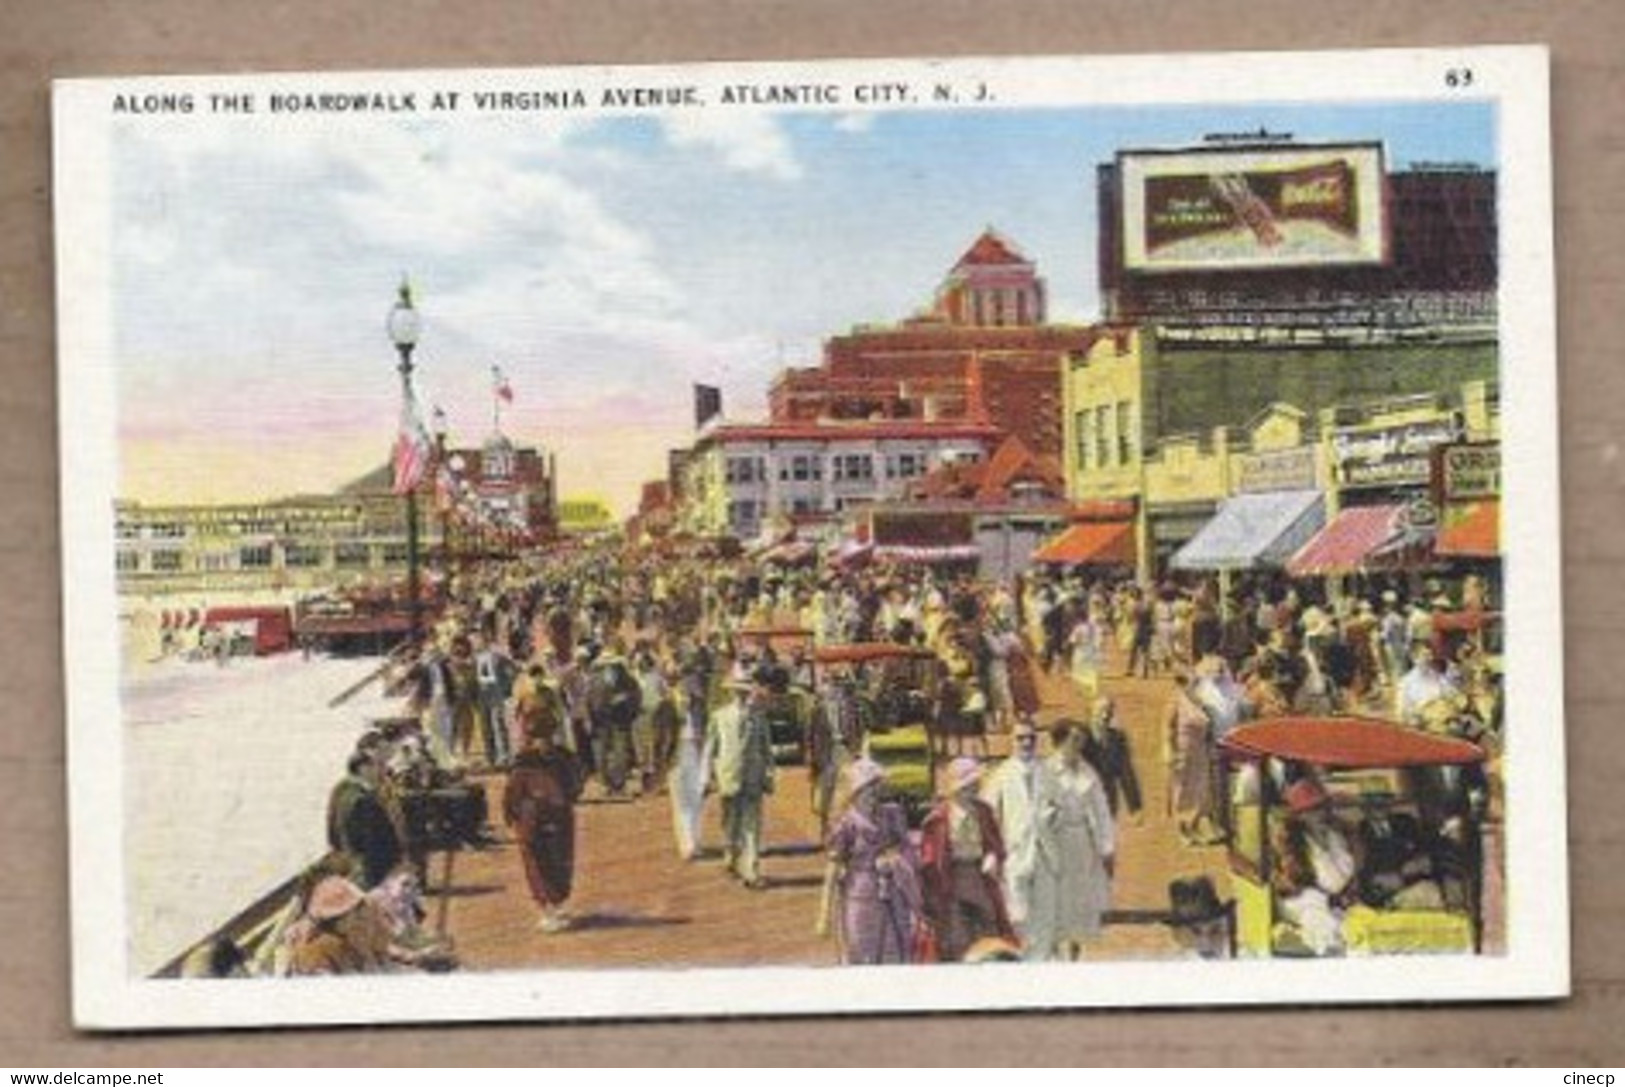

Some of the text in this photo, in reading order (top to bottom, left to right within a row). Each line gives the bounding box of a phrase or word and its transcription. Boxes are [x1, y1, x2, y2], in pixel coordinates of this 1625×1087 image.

[1446, 69, 1472, 88] 63
[113, 84, 996, 114] ALONG THE BOARDWALK AT VIRGINIA AVENUE, ATLANTIC CITY, N. J.
